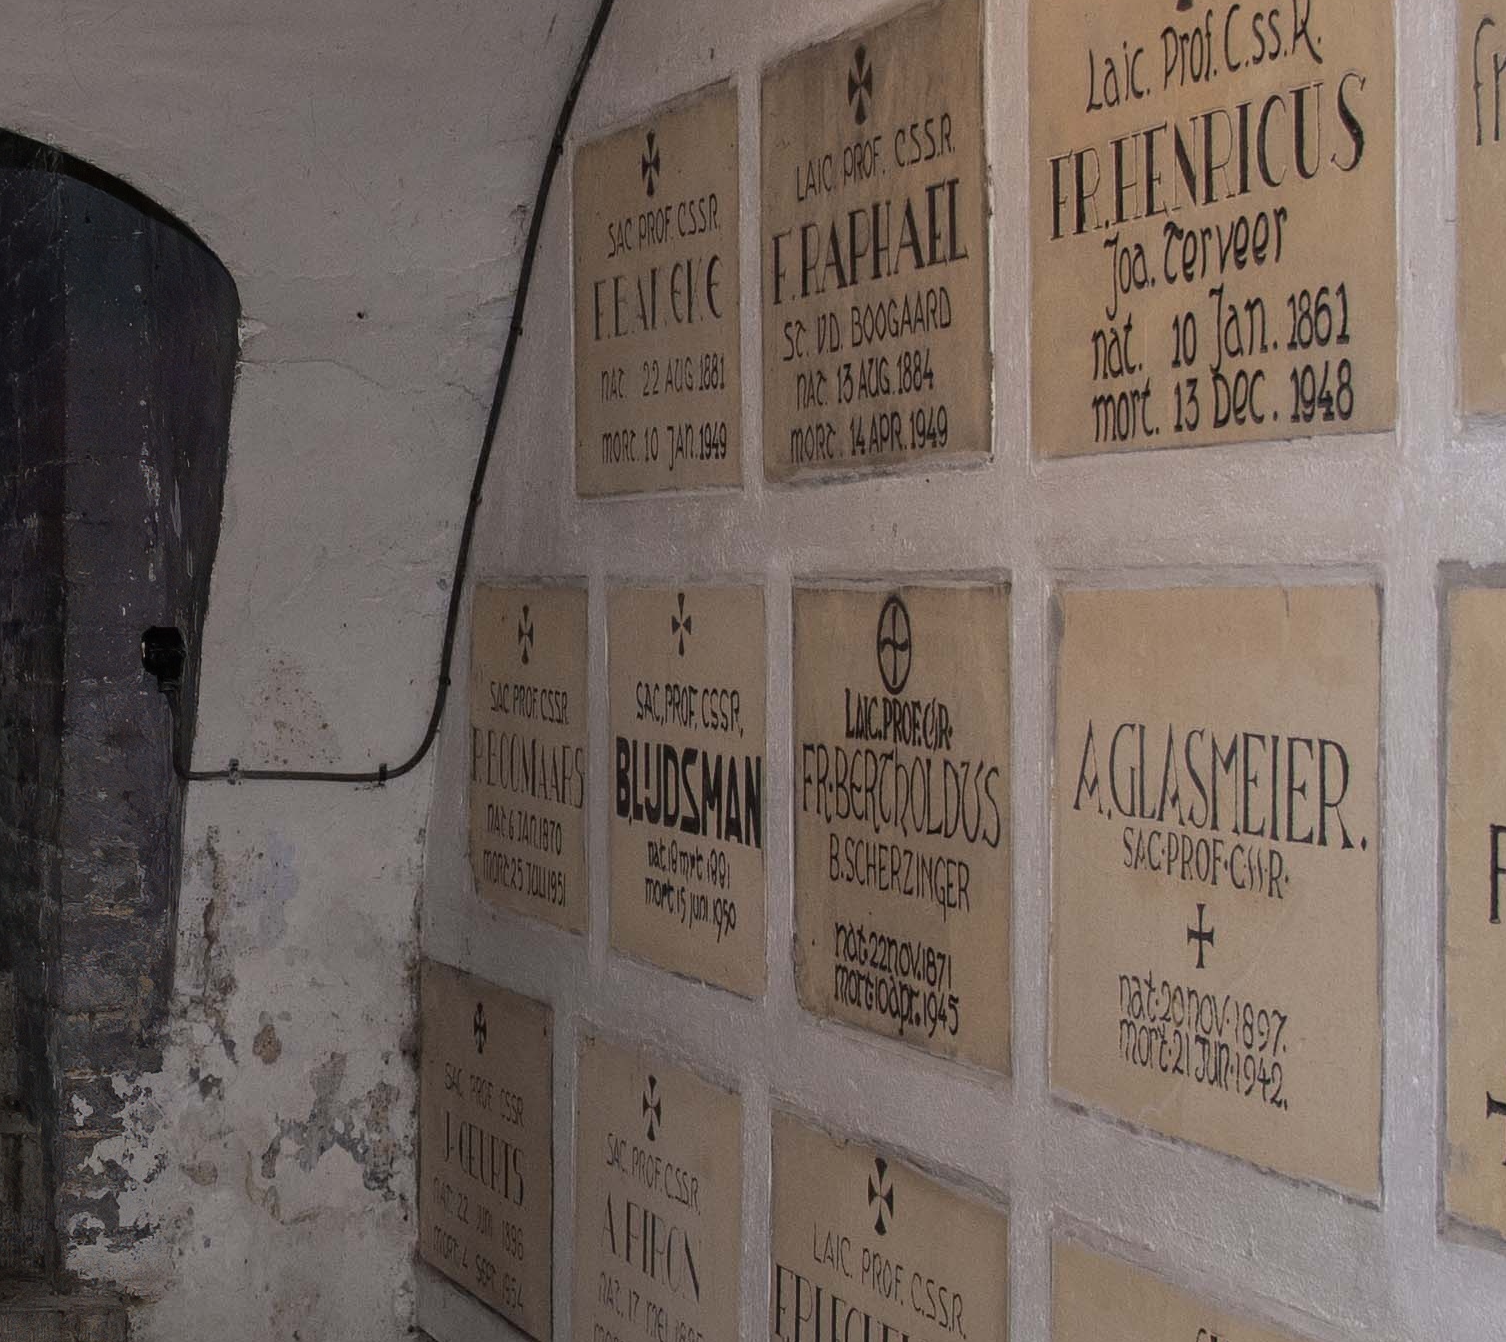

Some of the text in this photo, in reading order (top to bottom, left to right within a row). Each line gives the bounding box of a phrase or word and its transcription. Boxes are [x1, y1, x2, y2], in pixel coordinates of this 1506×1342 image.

[851, 286, 953, 348] BOOGAARD
[1171, 311, 1198, 370] 10
[1209, 282, 1279, 372] Jan.
[1288, 282, 1351, 351] 1861
[642, 360, 661, 396] 22
[1173, 378, 1199, 434] 13
[1290, 358, 1355, 423] 1948
